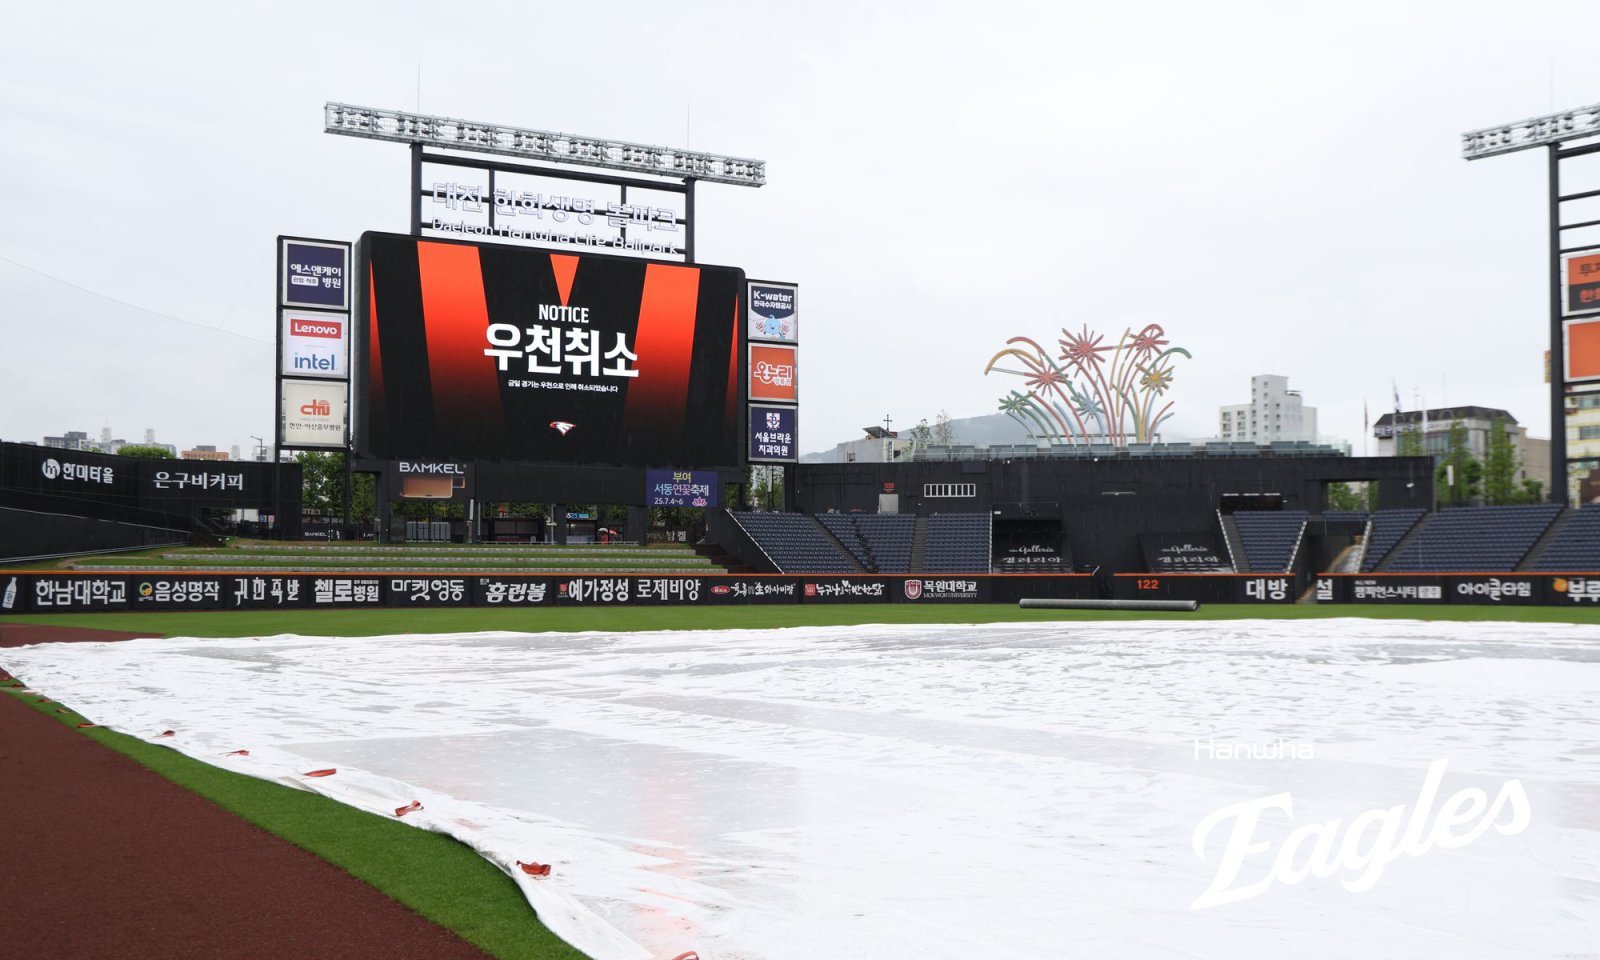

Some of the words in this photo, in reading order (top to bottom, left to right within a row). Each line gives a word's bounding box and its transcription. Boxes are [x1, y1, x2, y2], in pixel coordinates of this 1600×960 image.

[432, 182, 483, 213] 대전
[493, 188, 595, 226] 한화생명
[605, 201, 679, 232] 볼파크
[432, 217, 493, 237] Daejeon
[499, 226, 570, 244] Hanwha
[574, 233, 607, 248] Life
[612, 236, 678, 255] Ballpark
[290, 263, 342, 277] 에스앤케이
[322, 277, 342, 289] 병원
[753, 290, 793, 302] K-water
[753, 300, 792, 310] 한국수자원공사
[539, 304, 590, 323] NOTICE
[294, 322, 338, 335] Lenovo
[484, 323, 639, 378] 우천취소
[295, 352, 337, 371] intel
[507, 379, 521, 388] 금일
[521, 380, 540, 389] 경기는
[540, 382, 564, 391] 우천으로
[565, 383, 577, 391] 인해
[577, 384, 619, 393] 취소되었습니다
[755, 432, 792, 444] 서울브라운
[758, 445, 789, 456] 치과의원
[63, 462, 114, 484] 한미타올
[399, 462, 464, 474] BAMKEL
[672, 472, 692, 483] 부여
[153, 472, 244, 491] 은구비커피
[654, 483, 709, 496] 서동연꽃축제
[1018, 545, 1055, 554] Galleria
[36, 580, 126, 606] 한남대학교
[155, 581, 220, 602] 음성명작
[234, 577, 300, 606] 귀한족발
[486, 582, 546, 603] 홈런볼
[568, 579, 629, 602] 예가정성
[637, 579, 701, 601] 로제비앙
[923, 580, 978, 592] 목원대학교
[1137, 579, 1159, 590] 122
[1246, 579, 1288, 600] 대방
[1316, 579, 1333, 600] 설
